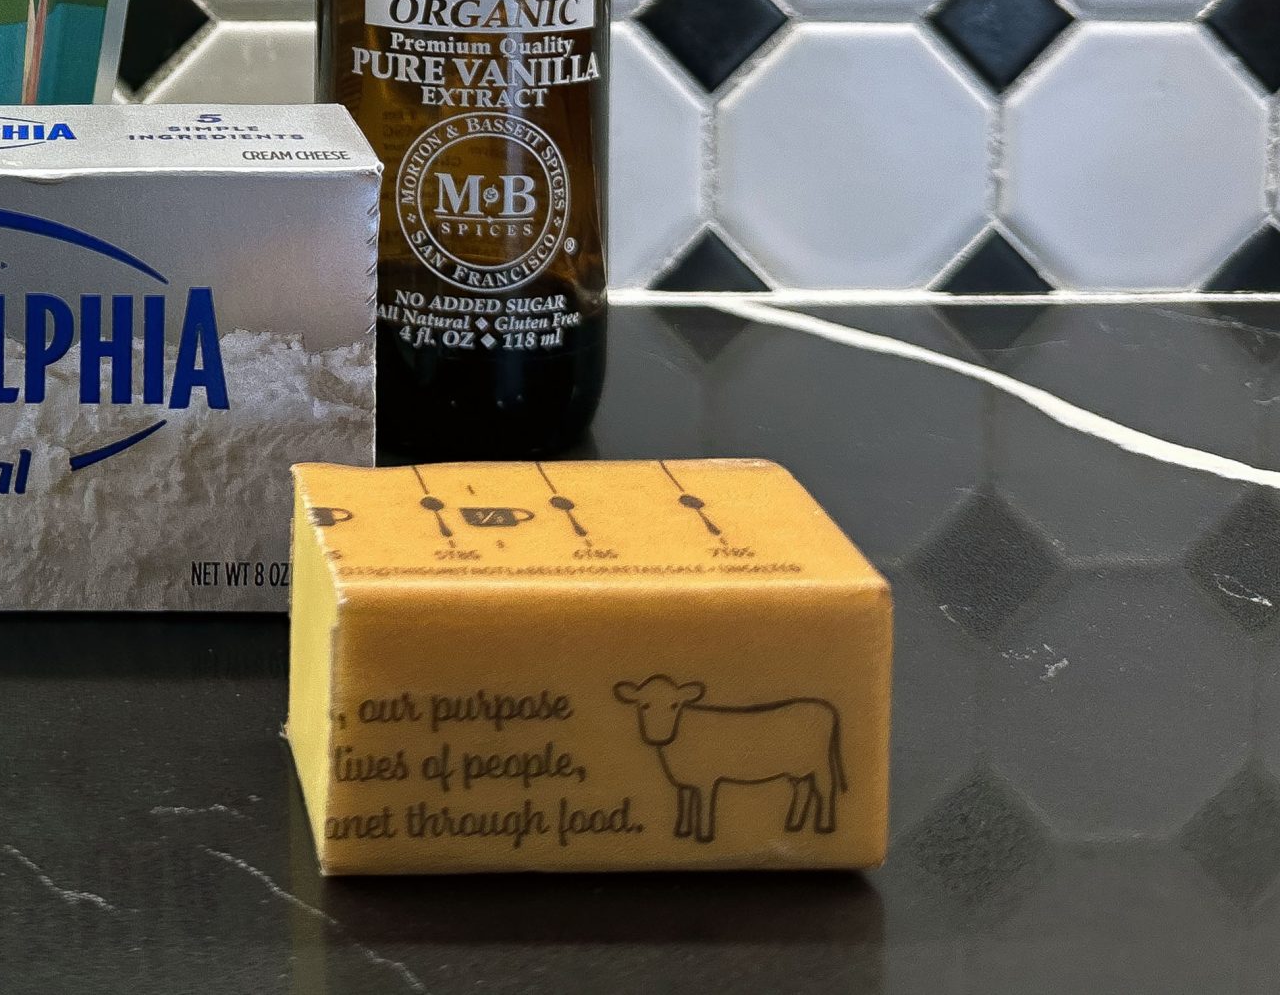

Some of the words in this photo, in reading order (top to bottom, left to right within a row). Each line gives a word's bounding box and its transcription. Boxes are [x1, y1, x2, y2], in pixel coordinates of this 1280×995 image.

[390, 32, 491, 54] Premium
[499, 37, 575, 59] Quality
[352, 47, 445, 85] PURE
[452, 51, 600, 87] VANILLA
[421, 86, 548, 108] EXTRACT
[197, 114, 222, 123] 5
[242, 150, 293, 161] CREAM
[295, 151, 351, 161] CHEESE
[401, 133, 443, 205] MORTON
[446, 125, 460, 139] &
[466, 118, 543, 148] BASSETT
[541, 145, 565, 211] SPICES
[441, 223, 533, 236] SPICES
[411, 230, 448, 268] SAN
[452, 234, 556, 287] FRANCISCO
[395, 290, 425, 306] NO
[428, 295, 501, 313] ADDED
[505, 294, 567, 313] SUGAR
[402, 307, 470, 328] Natural
[494, 315, 548, 332] Gluten
[551, 311, 581, 328] Free
[399, 325, 412, 342] 4
[413, 326, 437, 348] fl.
[442, 331, 476, 348] OZ
[502, 331, 536, 349] 118
[540, 328, 563, 347] ml
[191, 561, 220, 586] NET
[225, 562, 250, 586] WT
[254, 562, 265, 586] 8
[269, 562, 291, 586] OZ
[358, 691, 419, 723] our
[430, 689, 574, 733] purpose
[334, 745, 409, 782] lives
[422, 742, 453, 793] of
[463, 741, 586, 790] people,
[324, 806, 396, 840] anet
[405, 798, 550, 850] through
[556, 795, 645, 847] food.
